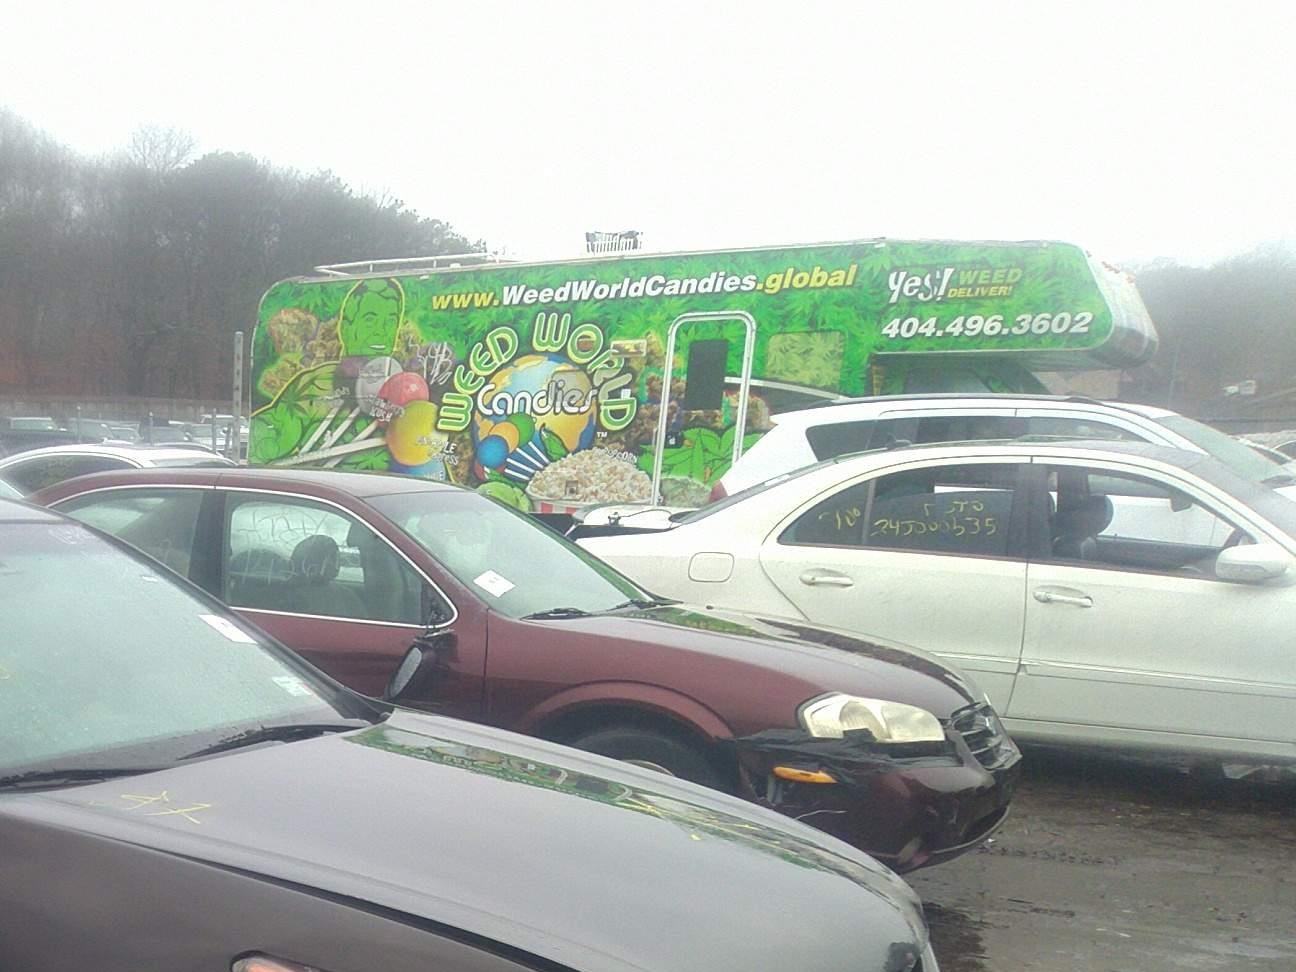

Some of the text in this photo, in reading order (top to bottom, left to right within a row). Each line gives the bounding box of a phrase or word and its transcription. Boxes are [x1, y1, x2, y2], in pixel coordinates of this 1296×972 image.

[431, 264, 857, 310] www.WeedWorldCandies.global
[947, 285, 1013, 299] DELIVER!
[959, 267, 1023, 285] WEED
[881, 311, 1094, 339] 404.496.3602
[436, 326, 520, 433] WEED
[531, 311, 639, 432] WORLD
[476, 379, 600, 417] Candies
